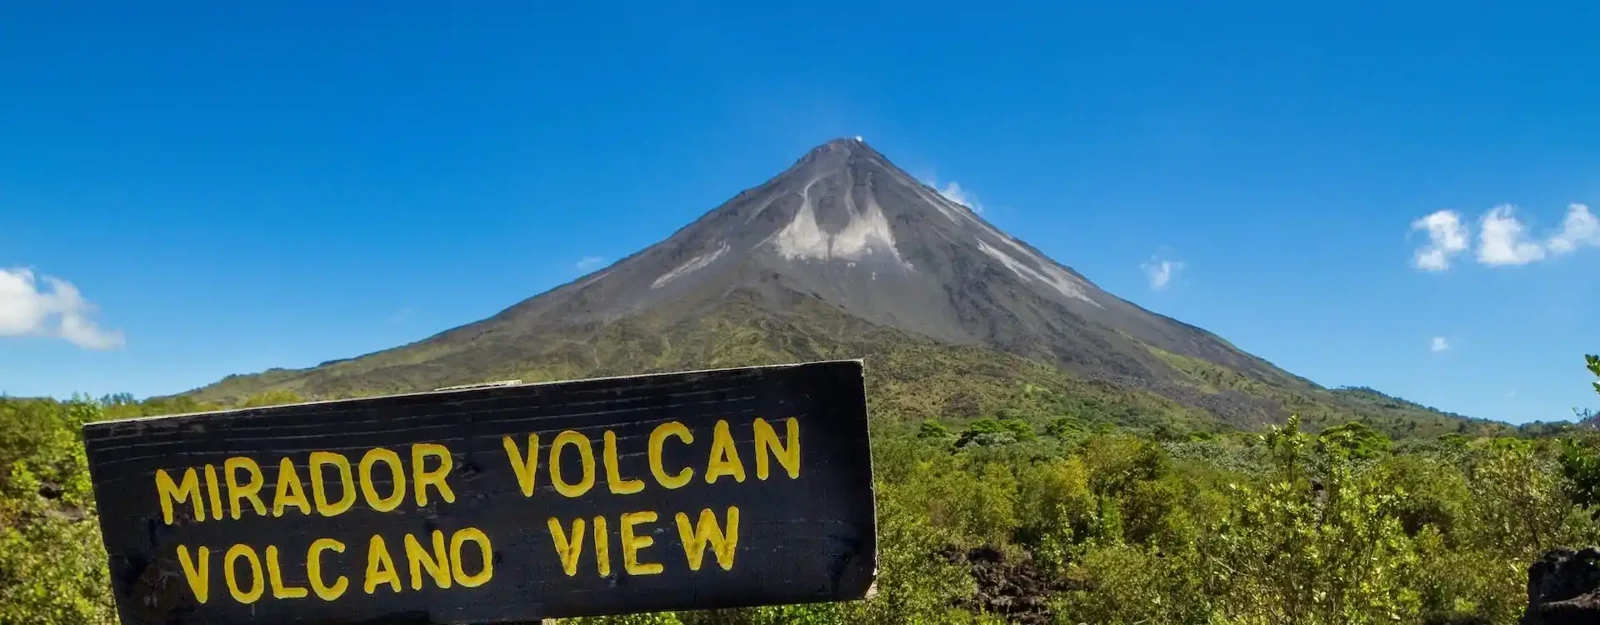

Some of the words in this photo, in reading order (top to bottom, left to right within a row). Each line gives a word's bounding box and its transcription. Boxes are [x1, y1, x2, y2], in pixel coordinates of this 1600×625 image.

[155, 443, 456, 524] MIRADOR
[502, 417, 801, 498] VOLCAN
[176, 526, 494, 604] VOLCANO
[547, 505, 740, 577] VIEW
